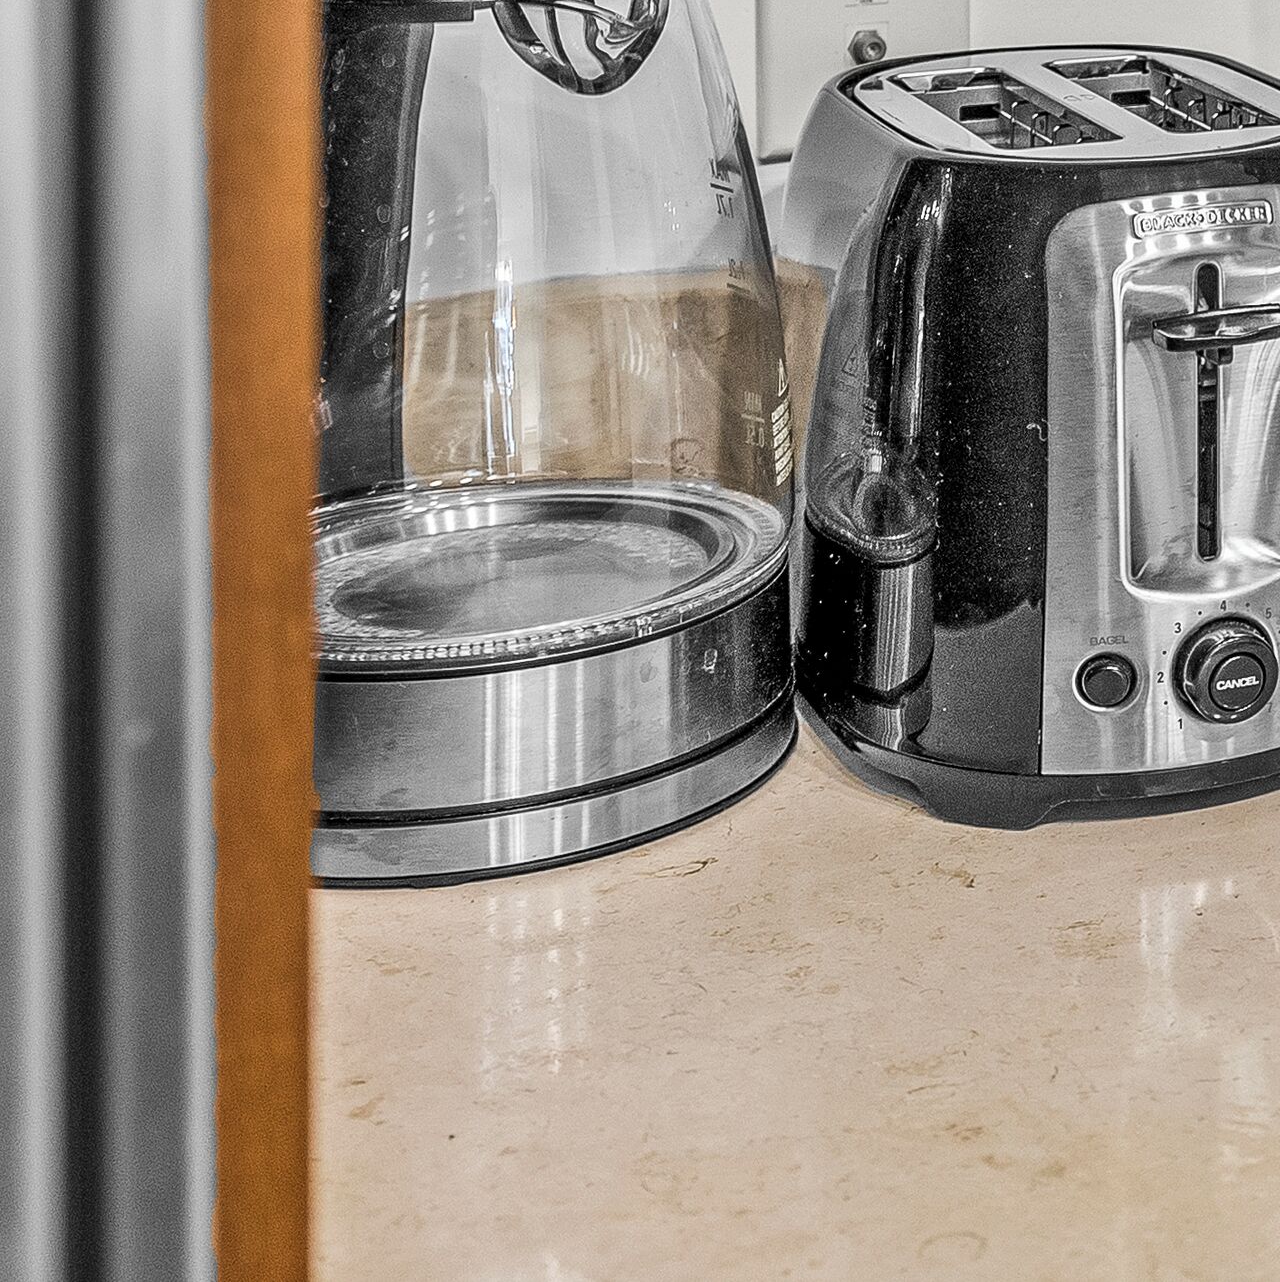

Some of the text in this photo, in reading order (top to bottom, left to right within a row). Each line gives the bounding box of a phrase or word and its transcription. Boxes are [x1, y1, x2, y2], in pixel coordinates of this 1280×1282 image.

[1220, 600, 1227, 611] 4
[1265, 608, 1272, 619] 5
[1174, 623, 1182, 634] 3
[1089, 635, 1128, 646] BAGEL
[1157, 672, 1164, 683] 2
[1216, 675, 1260, 690] CANCEL
[1178, 718, 1183, 729] 1
